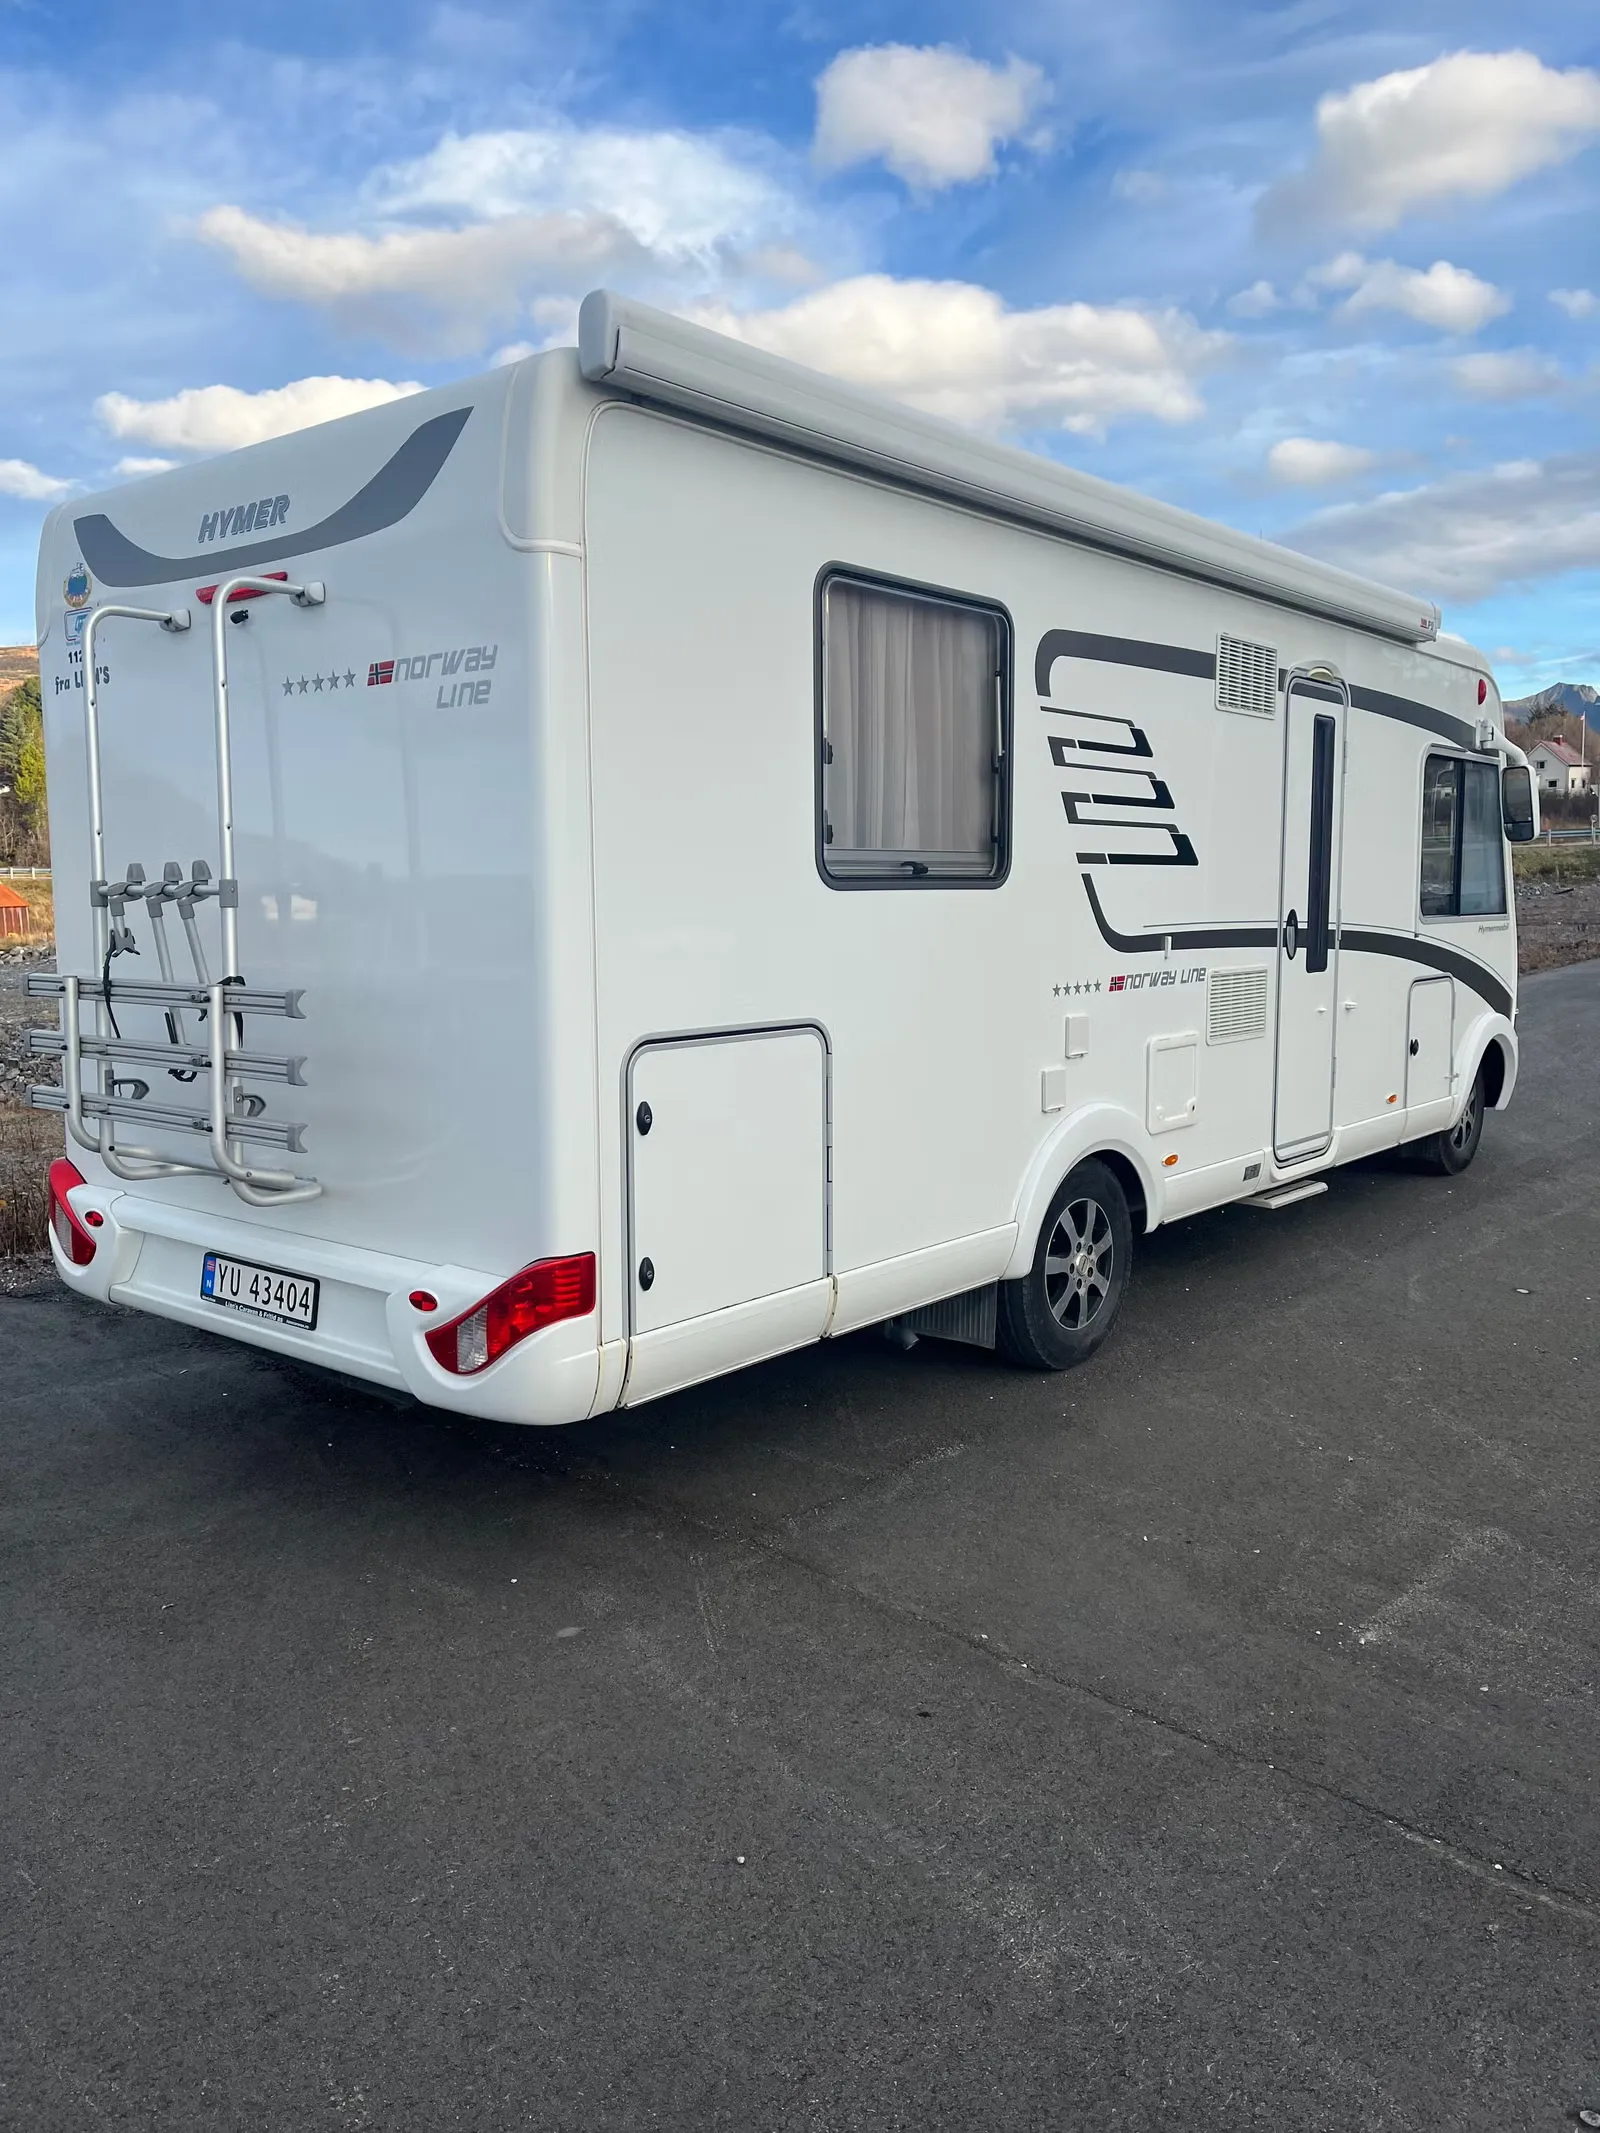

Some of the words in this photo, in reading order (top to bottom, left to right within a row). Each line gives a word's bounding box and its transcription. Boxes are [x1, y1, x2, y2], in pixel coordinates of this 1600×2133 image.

[197, 495, 290, 543] HYMER
[55, 675, 71, 695] fra
[206, 1279, 212, 1288] N
[218, 1263, 241, 1296] YU
[249, 1273, 310, 1316] 43404
